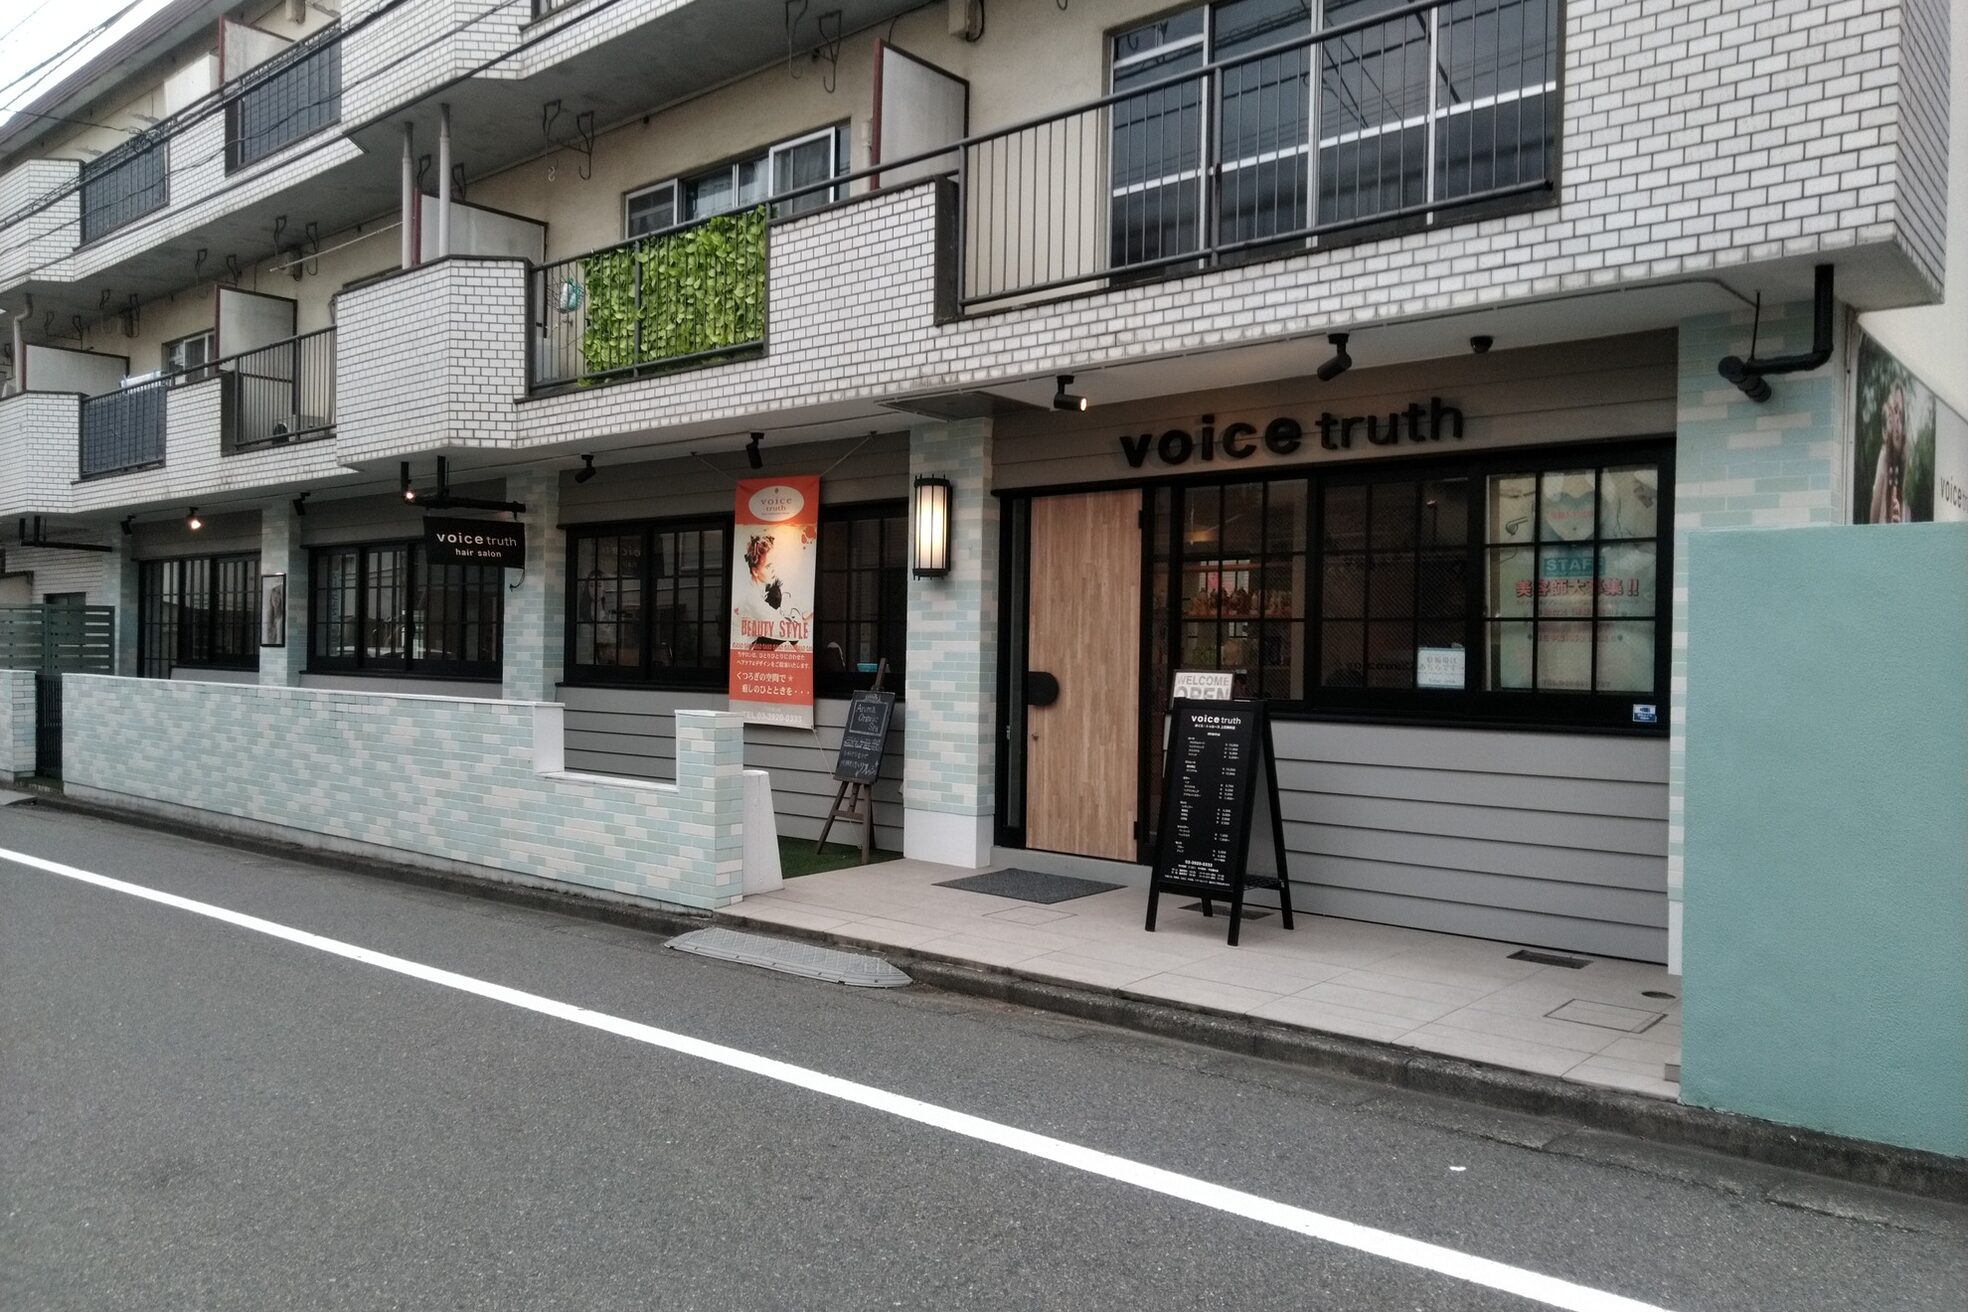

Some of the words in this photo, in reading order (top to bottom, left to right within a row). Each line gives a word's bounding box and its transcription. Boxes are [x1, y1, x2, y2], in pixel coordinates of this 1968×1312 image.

[1119, 415, 1303, 468] voice
[1315, 397, 1464, 450] truth
[1940, 475, 1962, 508] voice
[436, 532, 484, 545] voice
[486, 536, 517, 547] truth
[455, 548, 474, 557] hair
[477, 550, 502, 558] salon
[741, 619, 774, 637] BEAUTY
[779, 620, 809, 639] STYLE
[1176, 675, 1230, 687] WELCOME
[1191, 714, 1220, 724] voice
[1221, 717, 1241, 725] truth
